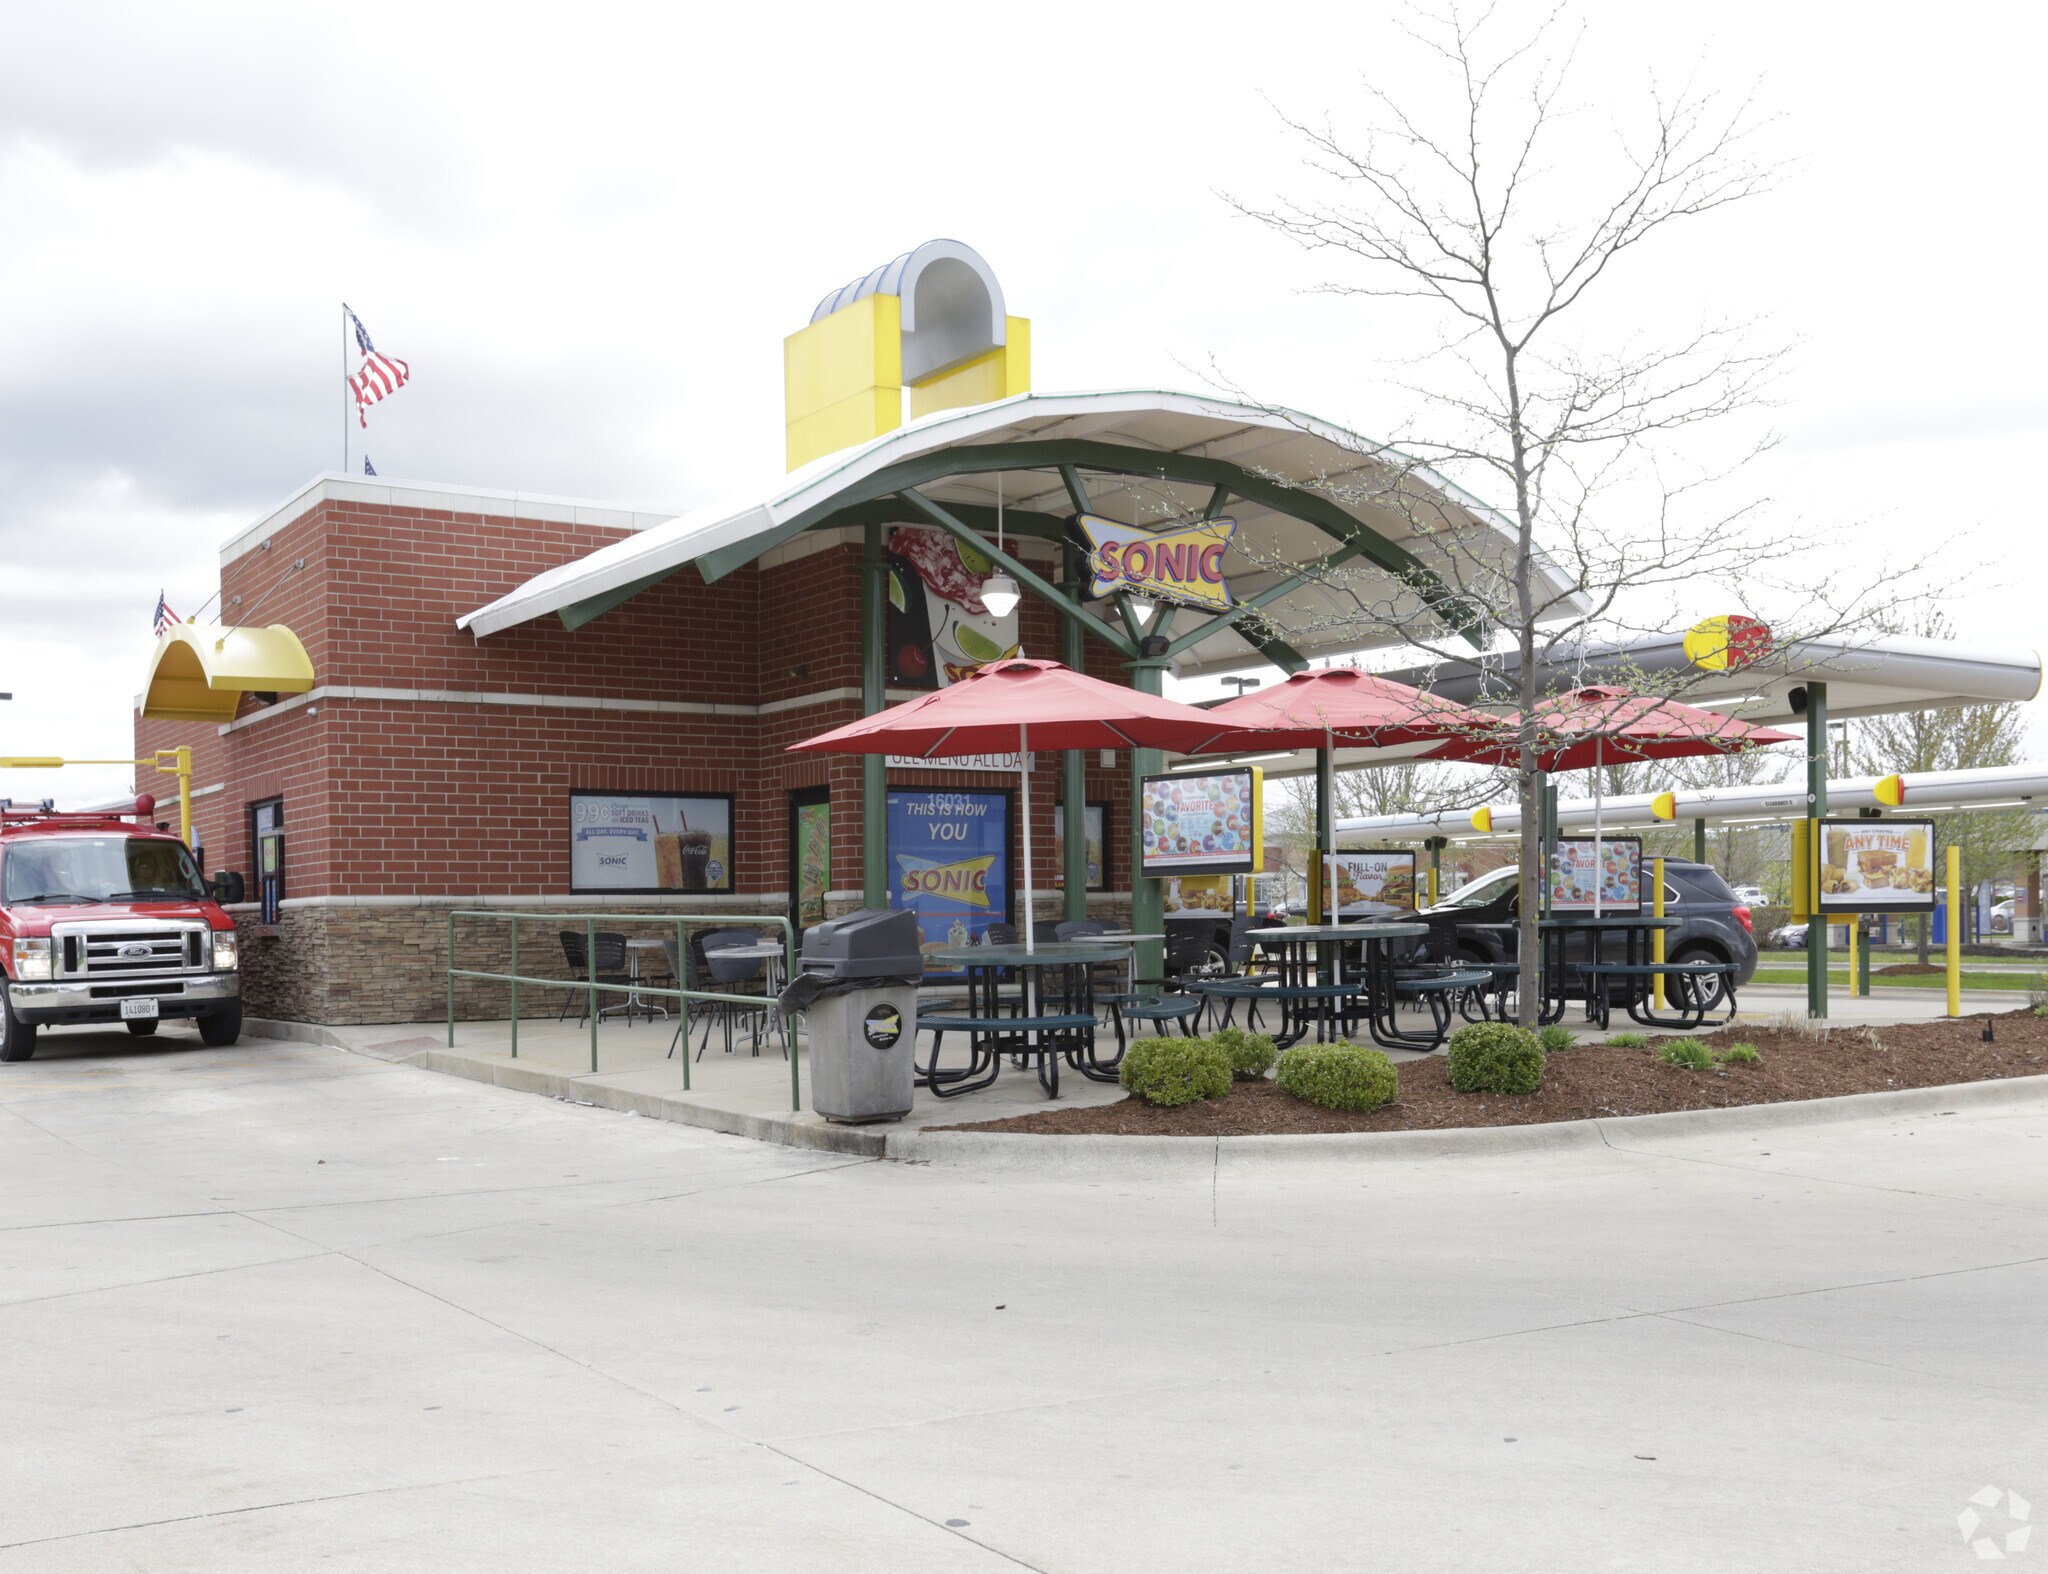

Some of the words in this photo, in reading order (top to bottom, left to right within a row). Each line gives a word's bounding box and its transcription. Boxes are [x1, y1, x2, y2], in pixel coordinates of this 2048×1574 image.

[1096, 541, 1225, 583] SONIC
[973, 753, 999, 768] ALL
[1003, 752, 1031, 768] DA
[927, 793, 971, 809] 16031
[1176, 799, 1215, 813] FAVORITE
[627, 809, 649, 817] DRINKS
[906, 803, 936, 816] THIS
[939, 803, 951, 816] IS
[955, 803, 988, 816] HOW
[619, 816, 633, 824] ICED
[635, 816, 649, 824] TEAS
[928, 822, 968, 841] YOU
[1845, 835, 1872, 850] ANY
[1877, 835, 1911, 851] TIME
[599, 857, 627, 865] SONIC
[1348, 861, 1388, 873] FULL-ON
[1571, 858, 1607, 869] FAVORE
[905, 869, 988, 893] SONIC
[1353, 871, 1383, 881] Flavor
[125, 1004, 150, 1015] 141080
